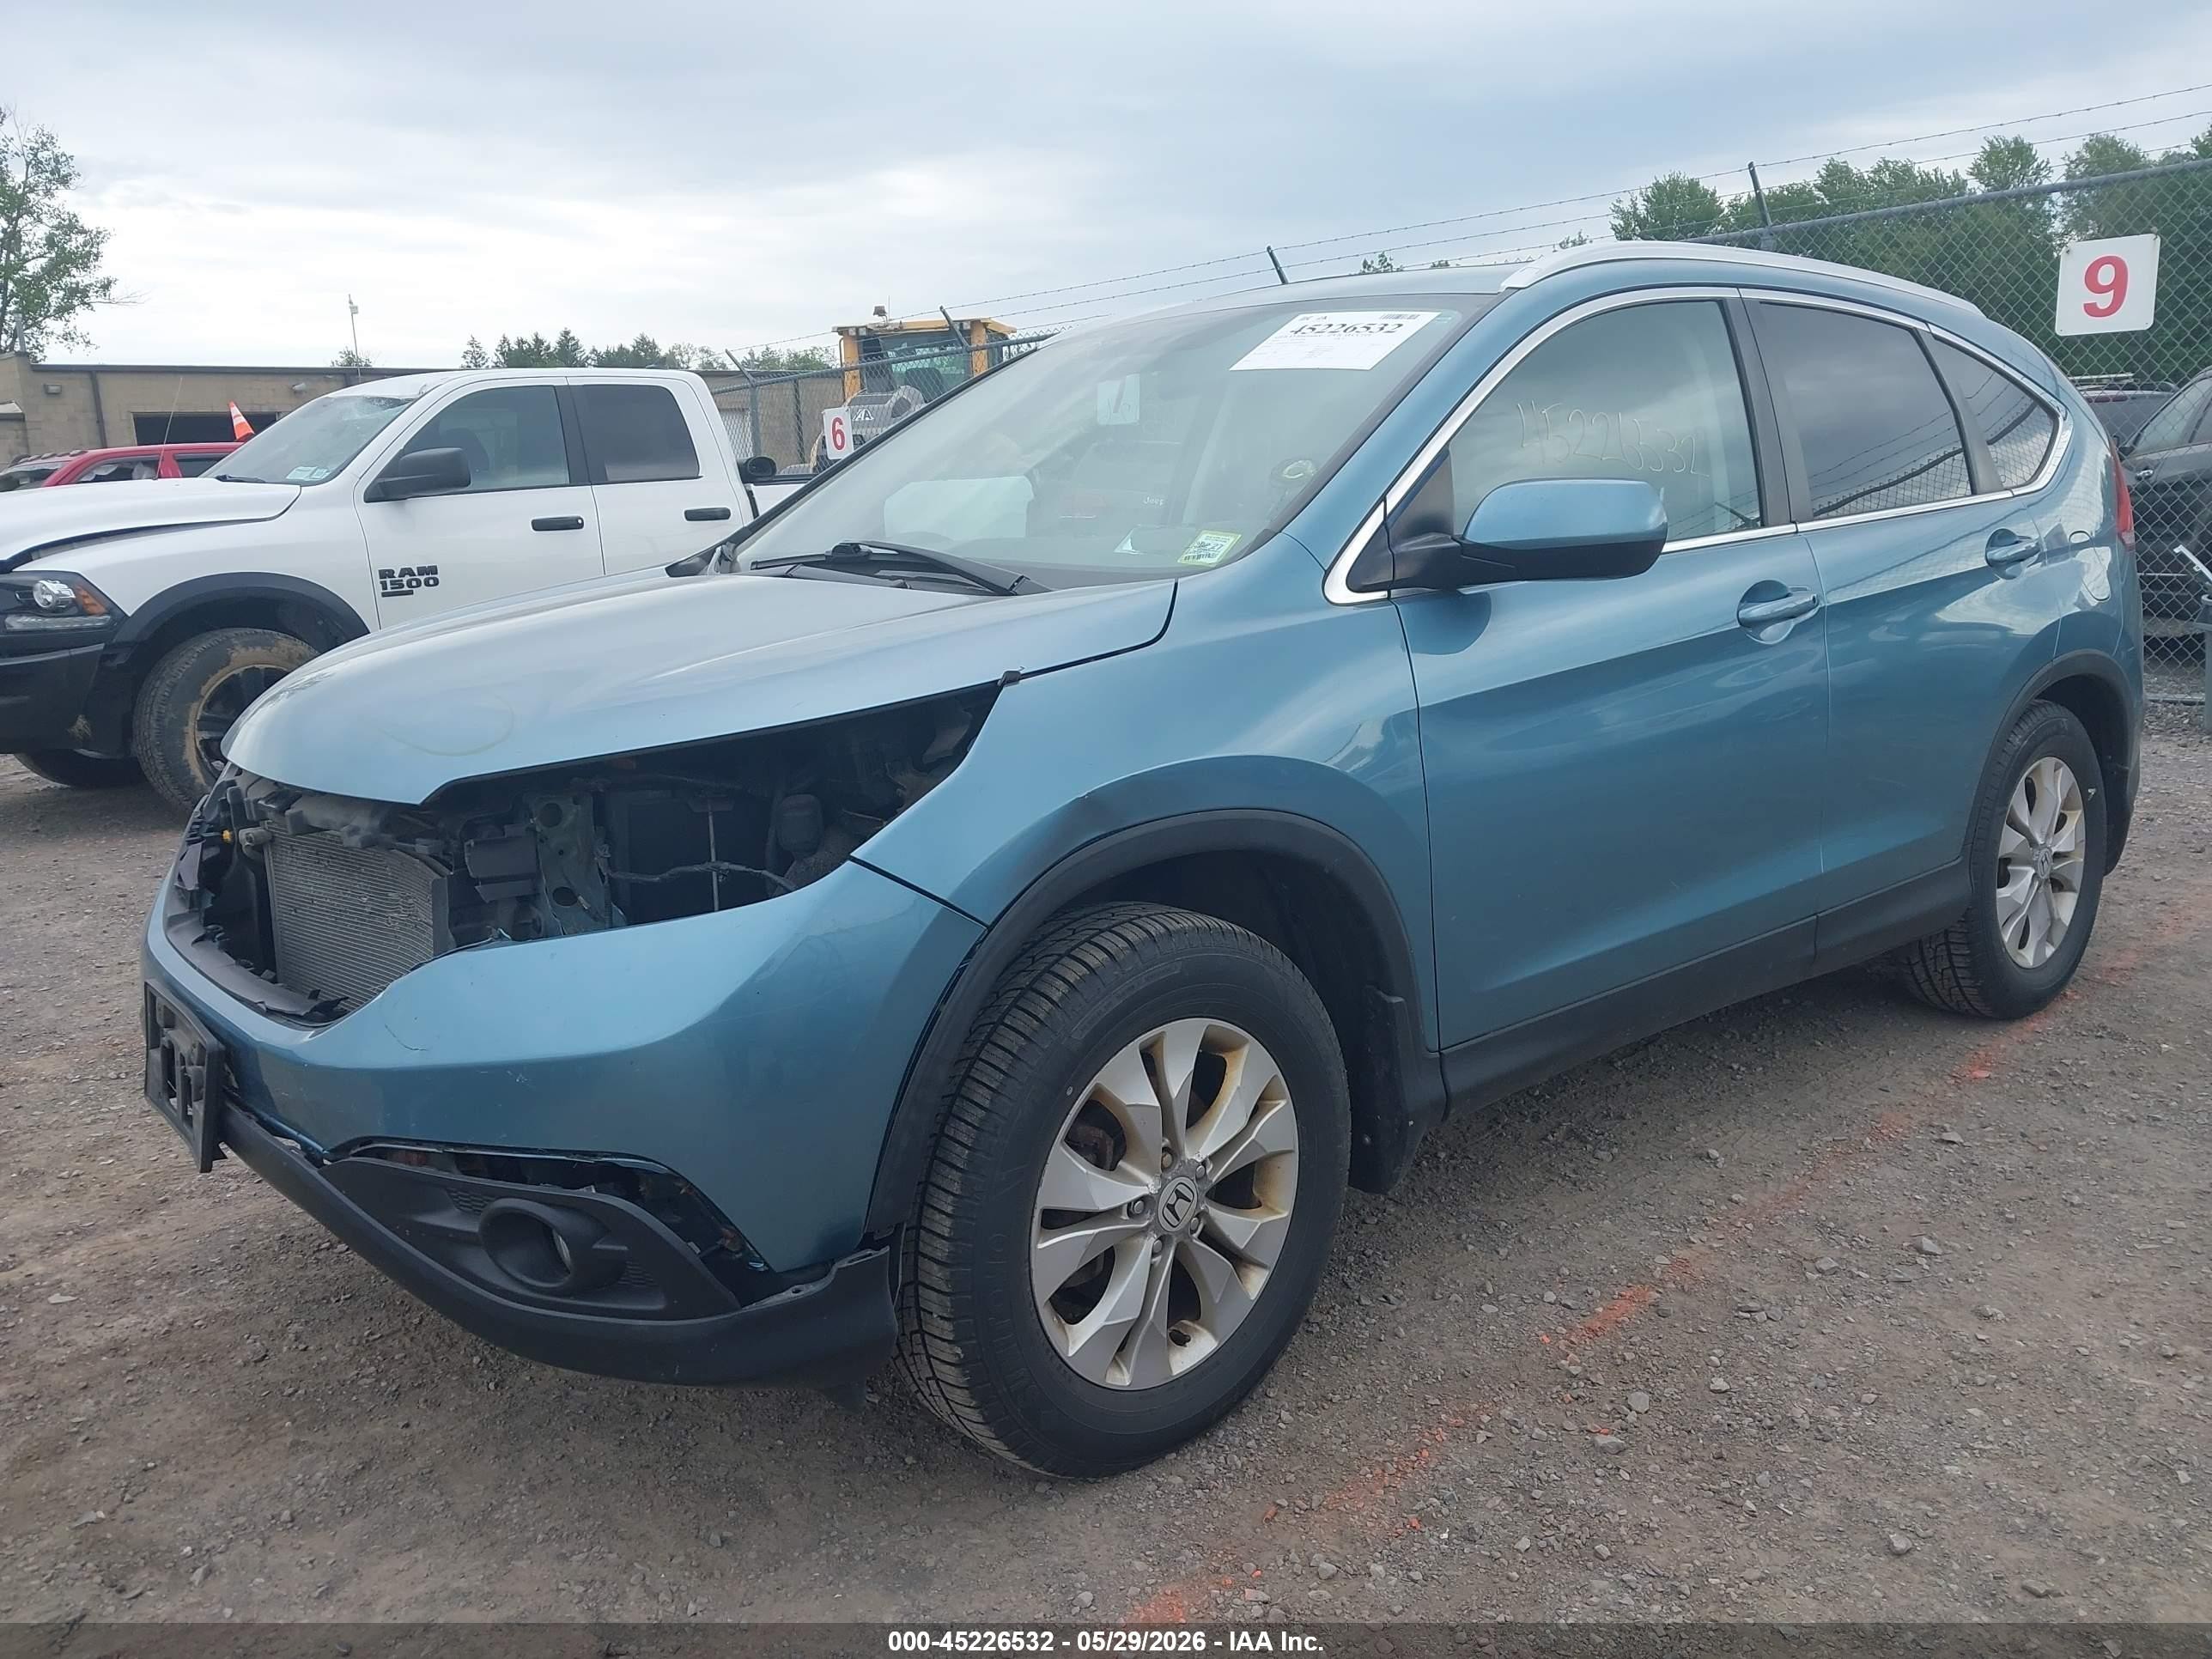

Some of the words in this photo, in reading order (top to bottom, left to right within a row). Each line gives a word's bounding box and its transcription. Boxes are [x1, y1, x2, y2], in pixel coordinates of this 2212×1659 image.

[2083, 255, 2129, 318] 9
[1289, 322, 1403, 334] 45226532
[831, 416, 846, 451] 6
[1517, 399, 1710, 477] 45226532
[378, 565, 438, 579] RAM
[380, 577, 439, 590] 1500
